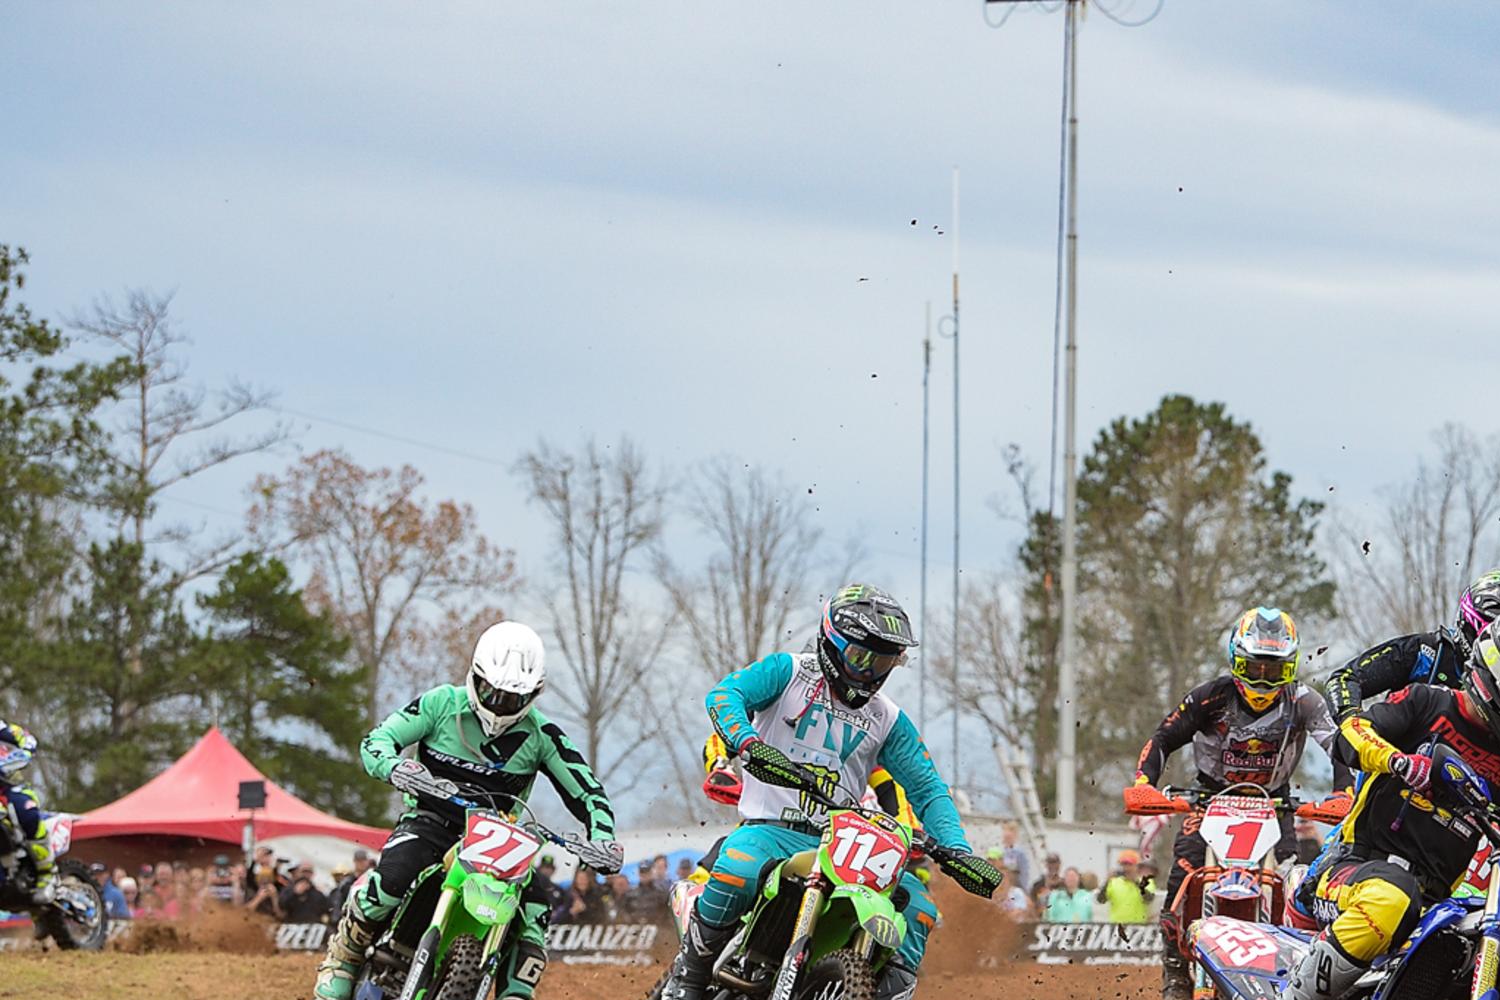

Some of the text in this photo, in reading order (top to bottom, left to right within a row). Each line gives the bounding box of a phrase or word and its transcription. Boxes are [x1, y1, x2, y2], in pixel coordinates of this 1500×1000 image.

[1222, 750, 1251, 767] Red
[458, 820, 540, 873] 27
[832, 826, 902, 889] 114
[1225, 821, 1264, 860] 1
[545, 923, 658, 951] ECIALIZED
